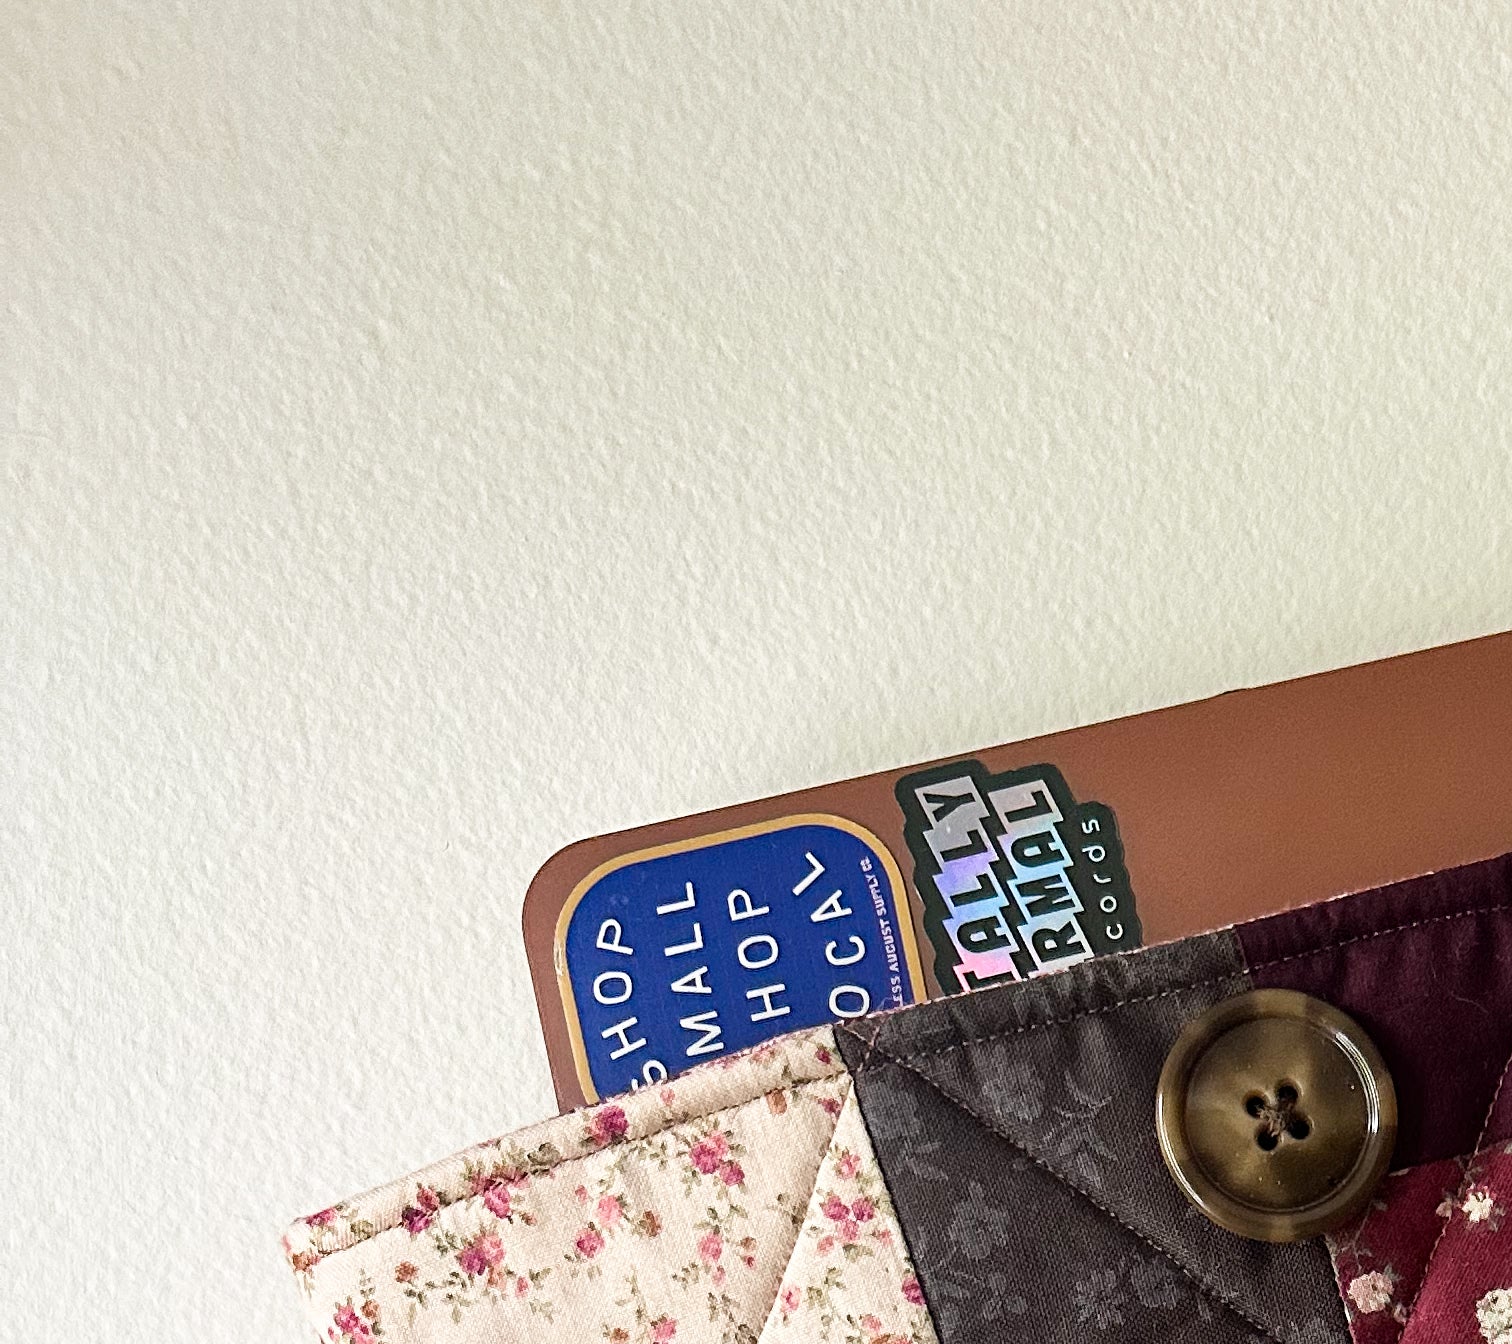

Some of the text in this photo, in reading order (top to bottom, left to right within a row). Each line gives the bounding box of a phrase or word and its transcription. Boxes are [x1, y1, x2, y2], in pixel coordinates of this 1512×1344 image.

[727, 889, 791, 1022] HOP
[792, 851, 871, 1019] OCAL
[879, 919, 900, 972] AUGUST
[923, 792, 1015, 989] TALLY
[1004, 790, 1086, 963] RMAL
[1081, 819, 1124, 940] cords
[593, 918, 668, 1090] SHOP
[656, 881, 724, 1057] MALL
